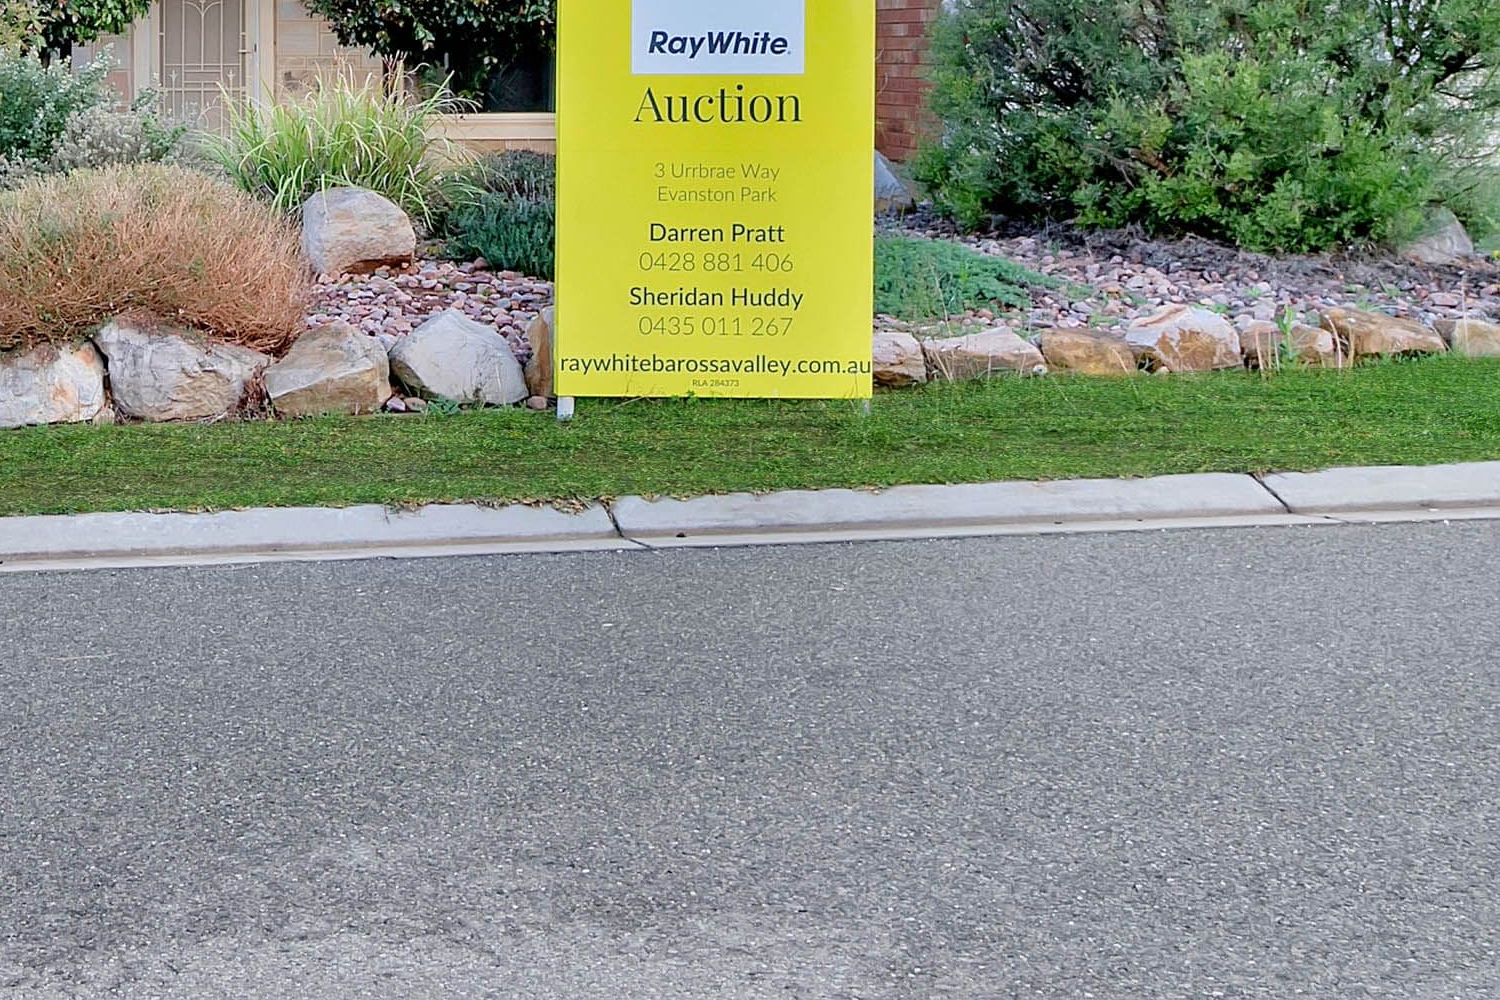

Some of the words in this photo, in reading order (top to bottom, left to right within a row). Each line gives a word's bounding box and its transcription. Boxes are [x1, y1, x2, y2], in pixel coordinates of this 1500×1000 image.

[633, 84, 803, 124] Auction
[654, 163, 665, 179] 3
[671, 162, 736, 179] Urrbrae
[741, 163, 780, 182] Way
[658, 186, 735, 202] Evanston
[741, 186, 777, 202] Park
[649, 223, 724, 242] Darren
[731, 224, 785, 243] Pratt
[639, 252, 695, 272] 0428
[703, 253, 743, 272] 881
[751, 253, 794, 272] 406
[629, 287, 723, 306] Sheridan
[731, 288, 804, 311] Huddy
[639, 316, 695, 336] 0435
[702, 317, 742, 336] 011
[751, 317, 793, 336] 267
[560, 354, 871, 377] raywhitebarossavalley.com.au
[692, 379, 708, 387] RLA
